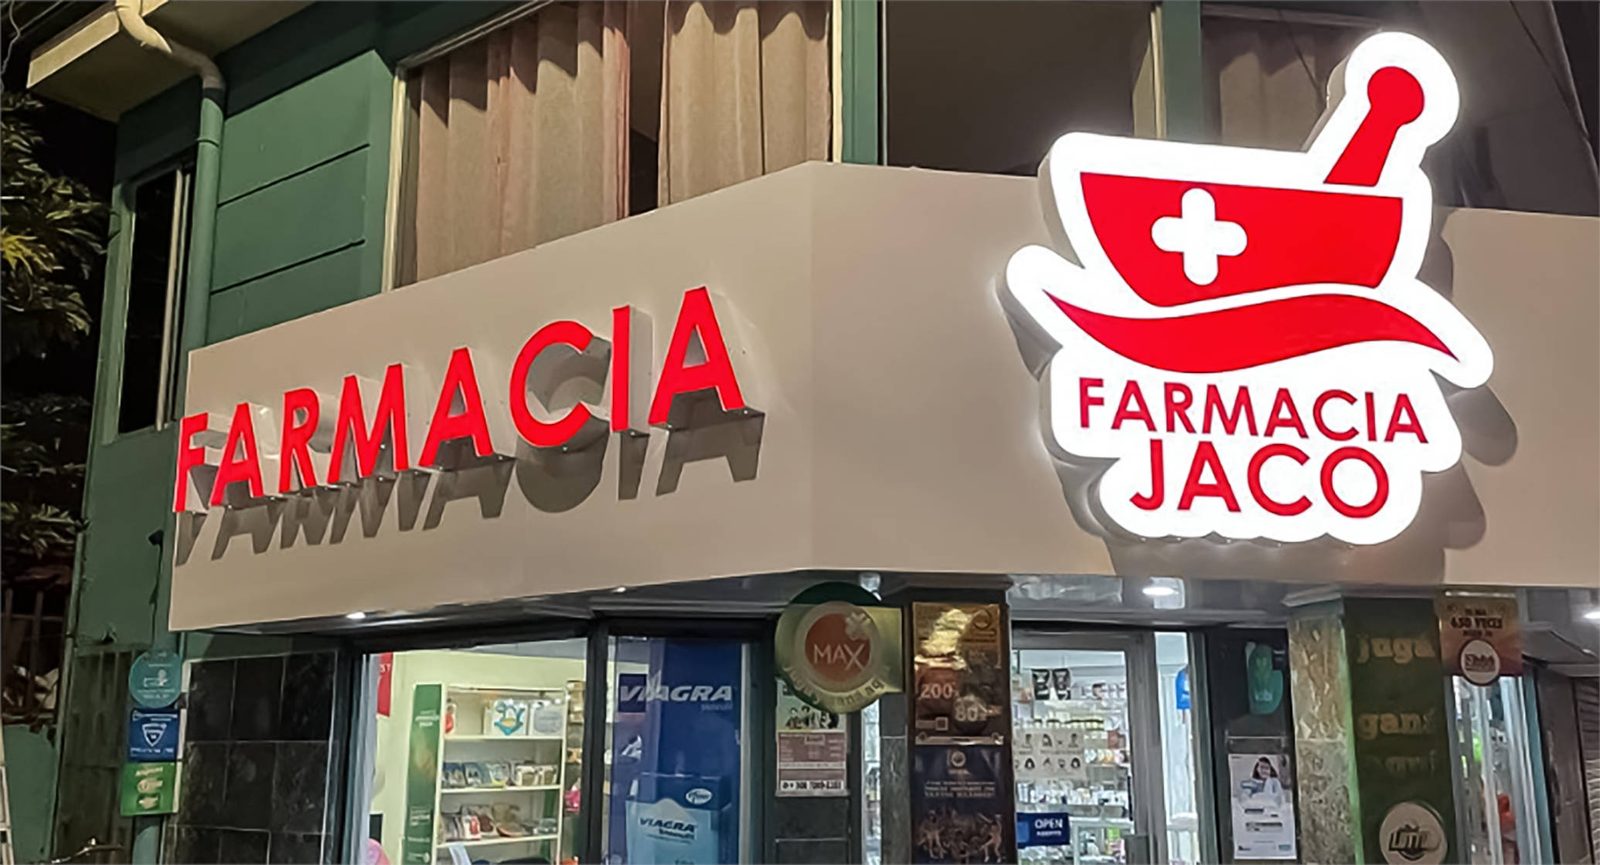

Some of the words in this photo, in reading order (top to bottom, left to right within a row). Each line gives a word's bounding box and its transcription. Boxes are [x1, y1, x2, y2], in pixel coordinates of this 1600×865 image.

[173, 287, 746, 514] FARMACIA
[1079, 377, 1428, 443] FARMACIA
[1130, 439, 1389, 519] JACO
[813, 643, 865, 672] MAX
[619, 685, 733, 701] VIAGRA
[640, 817, 697, 832] VIAGRA
[1034, 818, 1063, 829] OPEN
